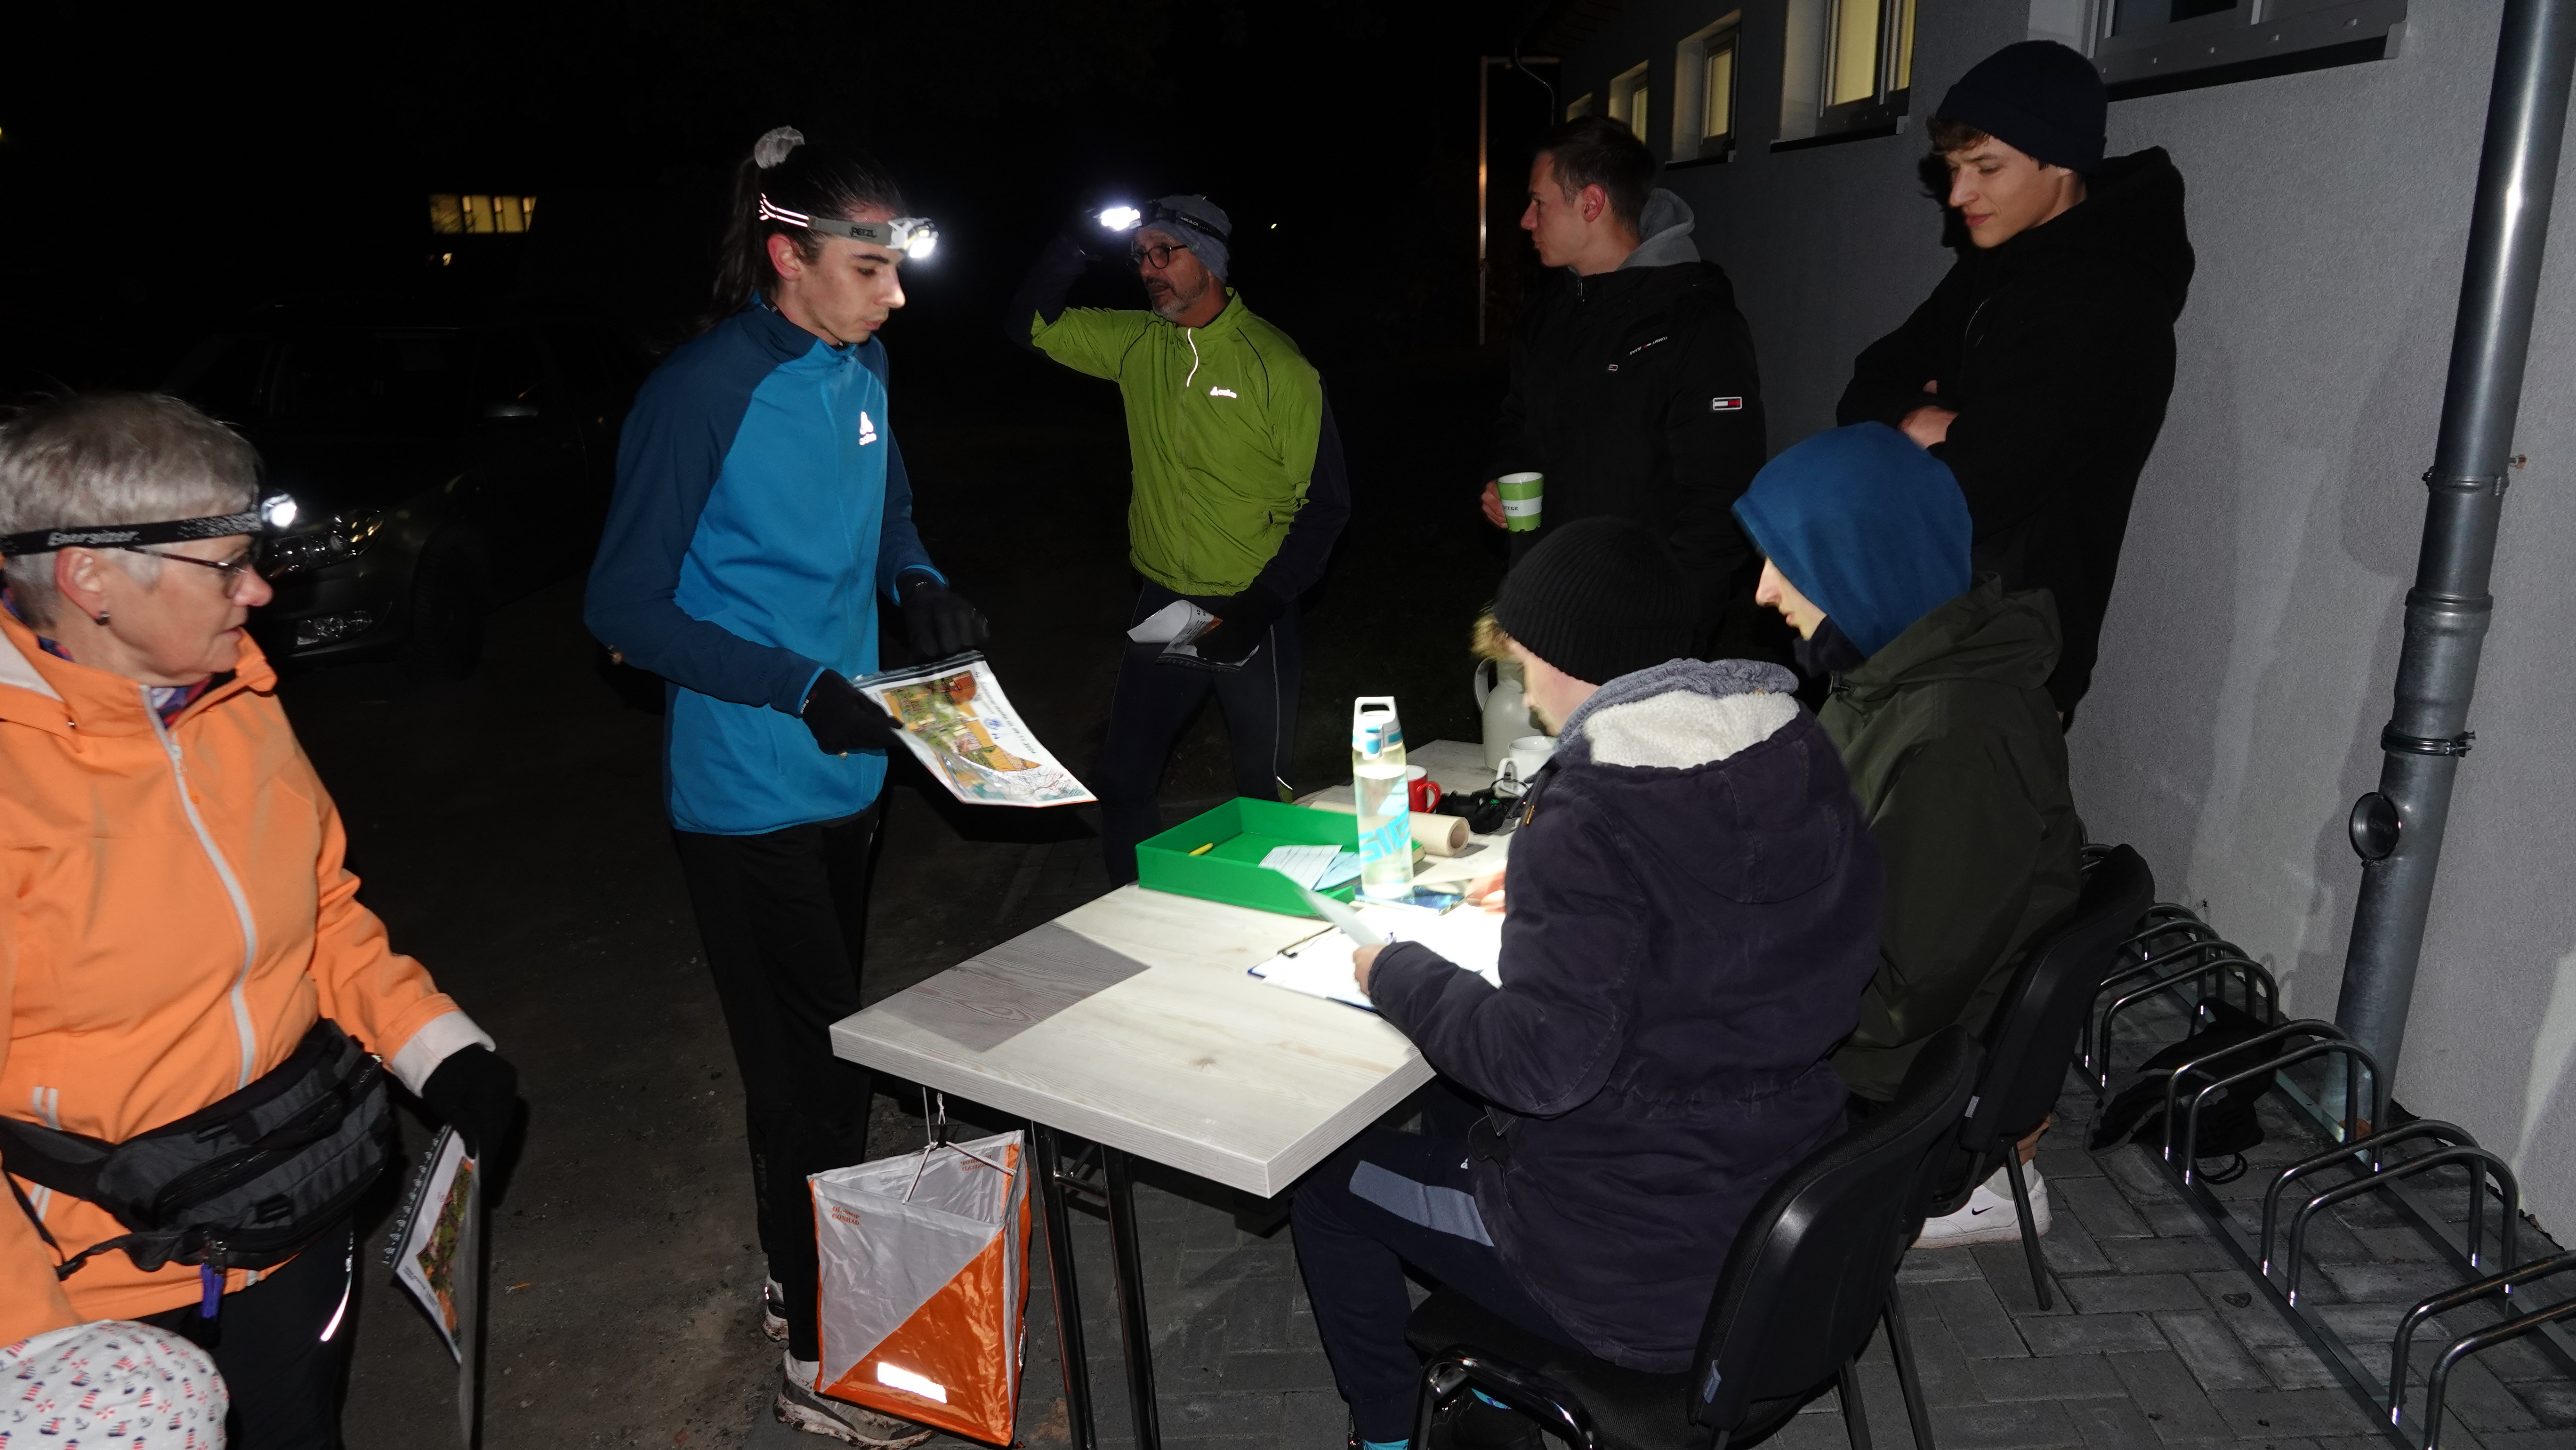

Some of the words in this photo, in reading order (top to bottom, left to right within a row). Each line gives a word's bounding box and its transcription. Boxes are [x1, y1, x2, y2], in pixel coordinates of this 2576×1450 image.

[1652, 336, 1668, 345] TOMMY
[1629, 346, 1642, 355] JEANS
[48, 530, 140, 547] Energizer
[832, 1214, 860, 1225] CONRAD
